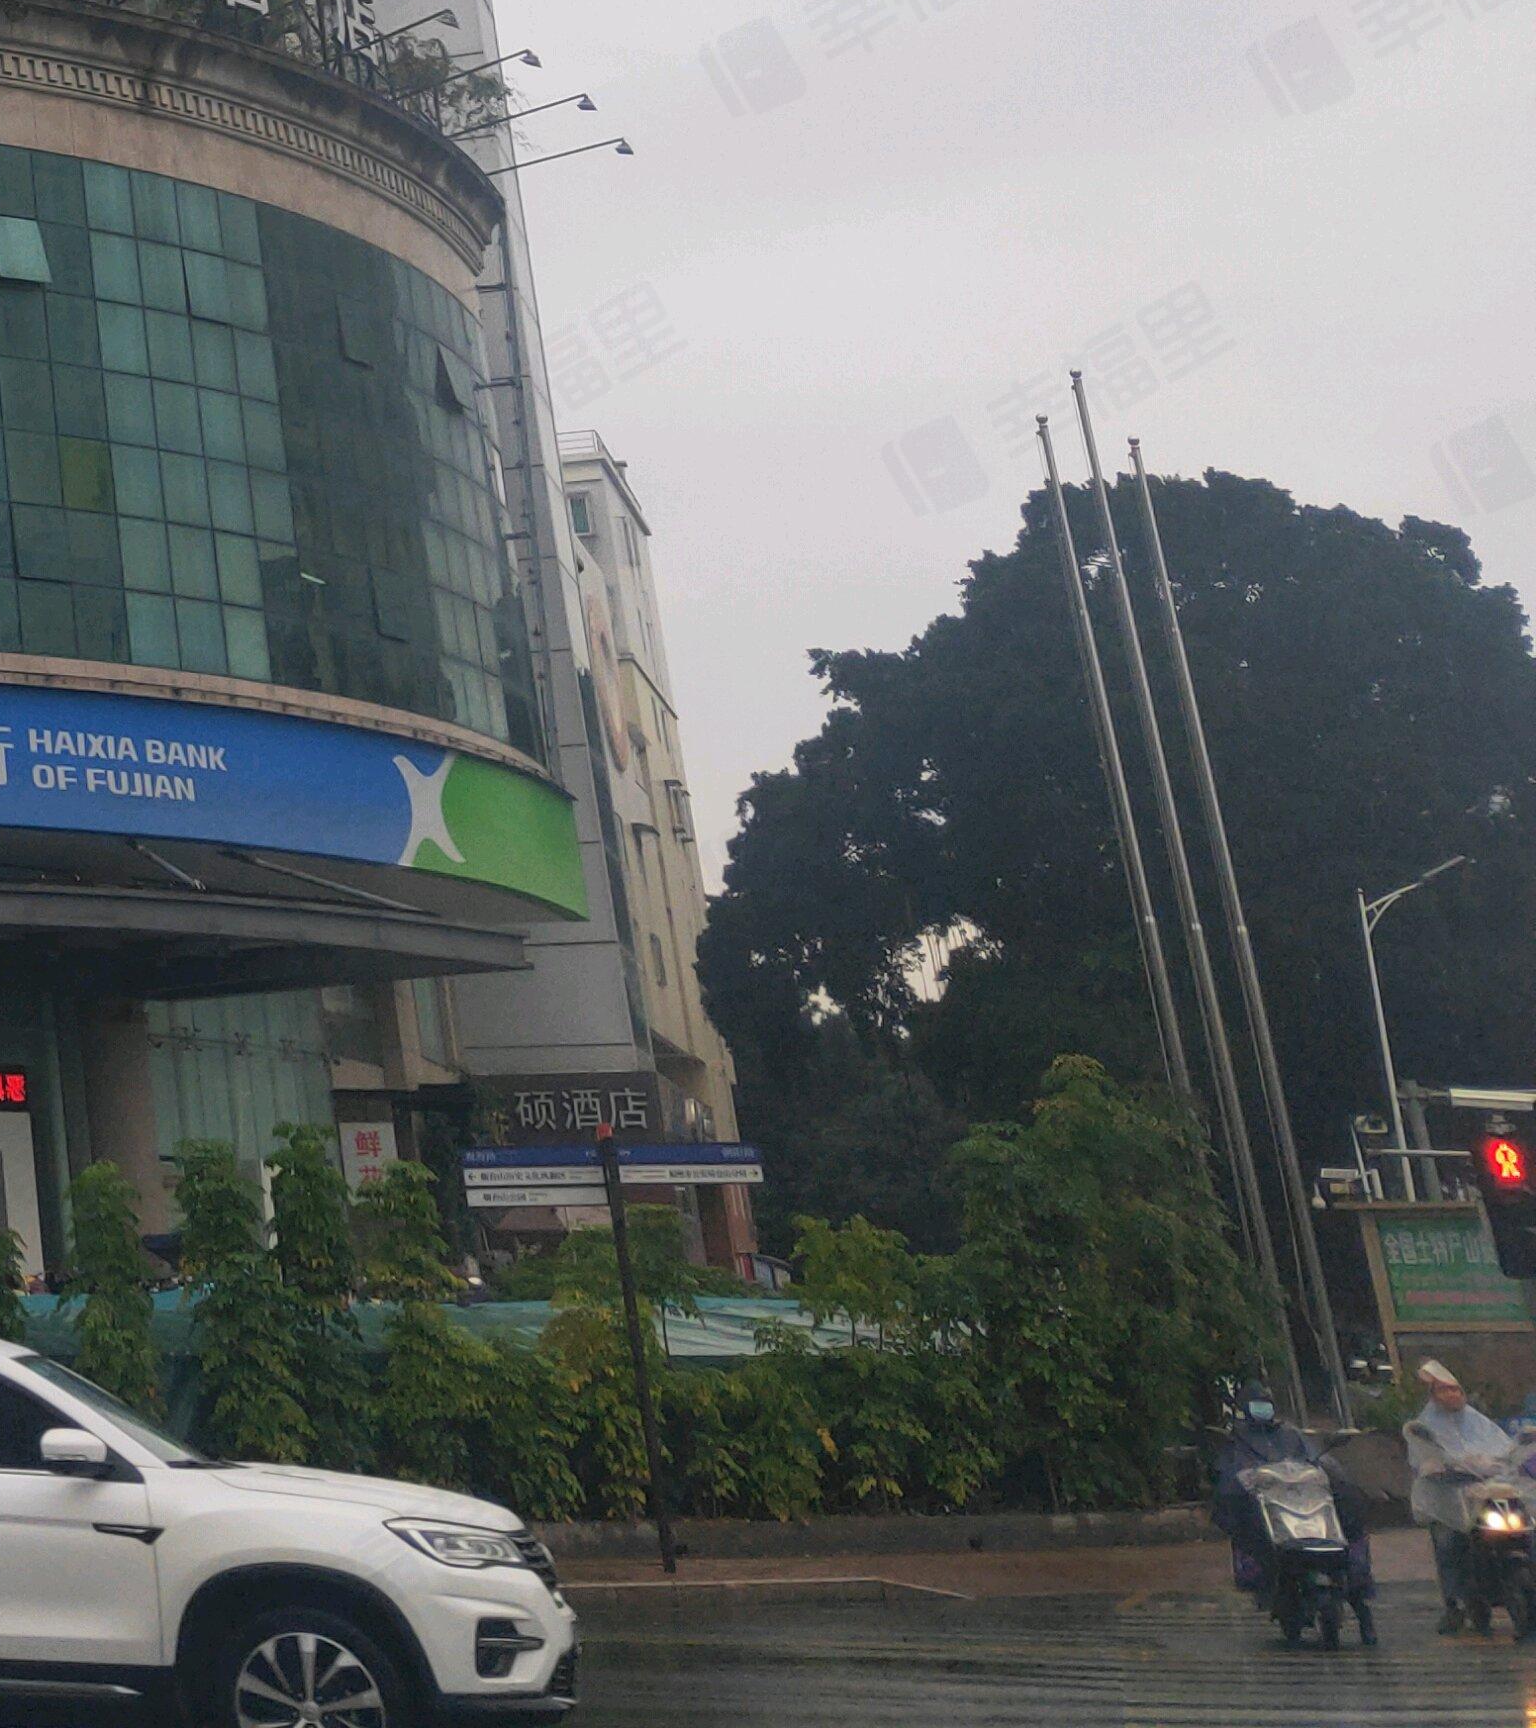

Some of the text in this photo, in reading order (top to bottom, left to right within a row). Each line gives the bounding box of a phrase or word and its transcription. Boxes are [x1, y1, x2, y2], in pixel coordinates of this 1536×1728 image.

[28, 728, 228, 774] HAIXIA BANK
[33, 763, 197, 804] OF FUJIAN
